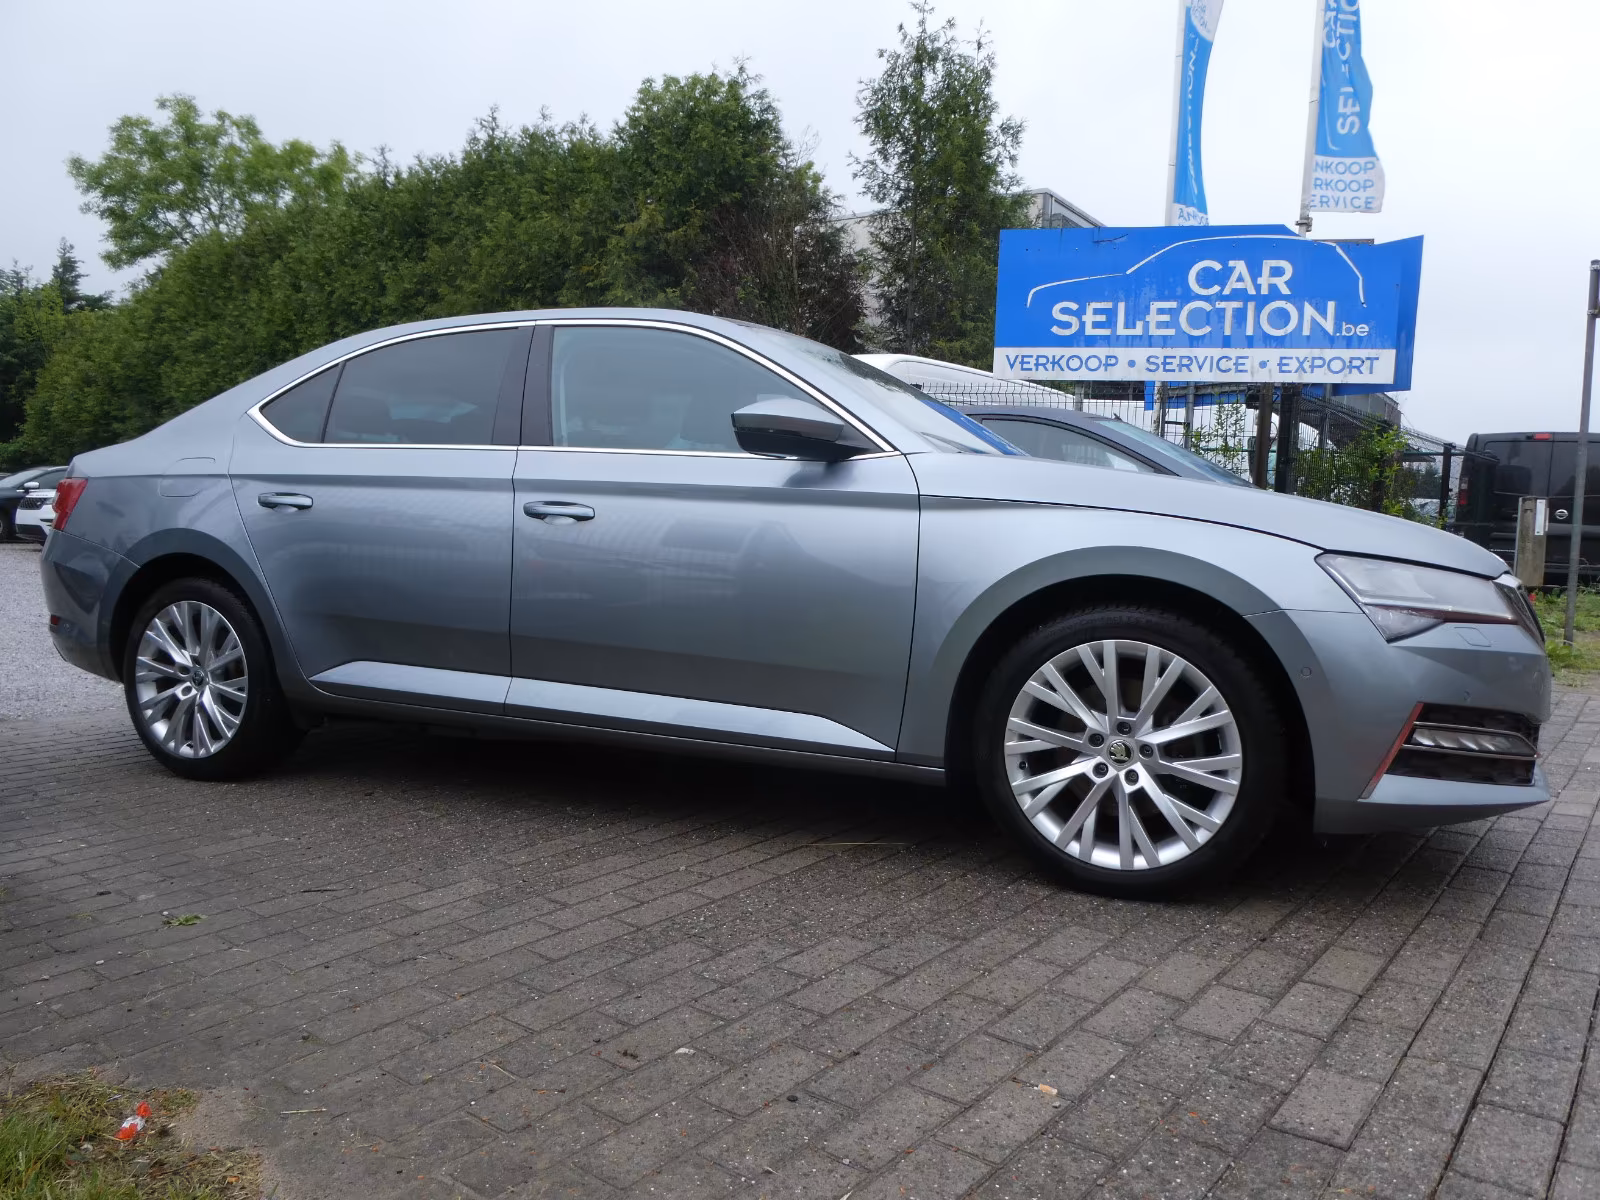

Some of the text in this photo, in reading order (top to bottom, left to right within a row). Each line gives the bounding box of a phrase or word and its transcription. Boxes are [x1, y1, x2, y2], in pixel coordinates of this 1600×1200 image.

[1188, 260, 1293, 296] CAR
[1006, 354, 1380, 375] VERKOOP SERVICE EXPORT
